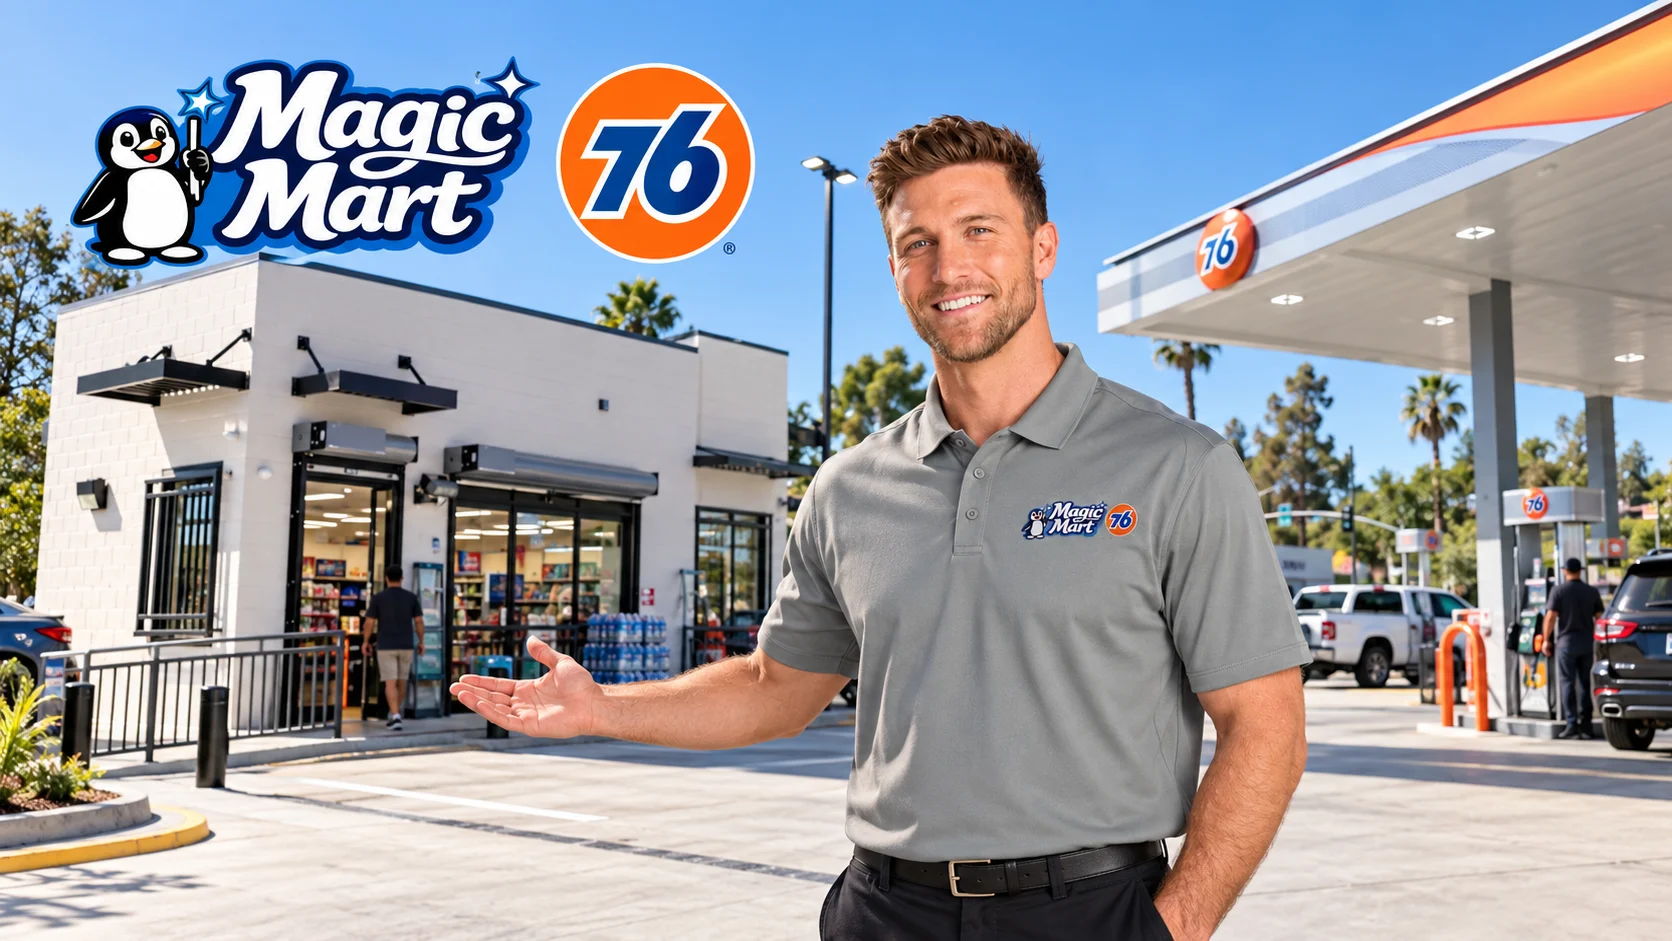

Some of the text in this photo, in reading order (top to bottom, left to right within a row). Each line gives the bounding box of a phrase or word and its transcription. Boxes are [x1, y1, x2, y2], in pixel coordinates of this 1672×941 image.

[1202, 225, 1237, 274] 76
[1049, 502, 1104, 522] Magic
[1526, 495, 1545, 513] 76
[1049, 518, 1095, 534] Mart
[1109, 510, 1133, 529] 76
